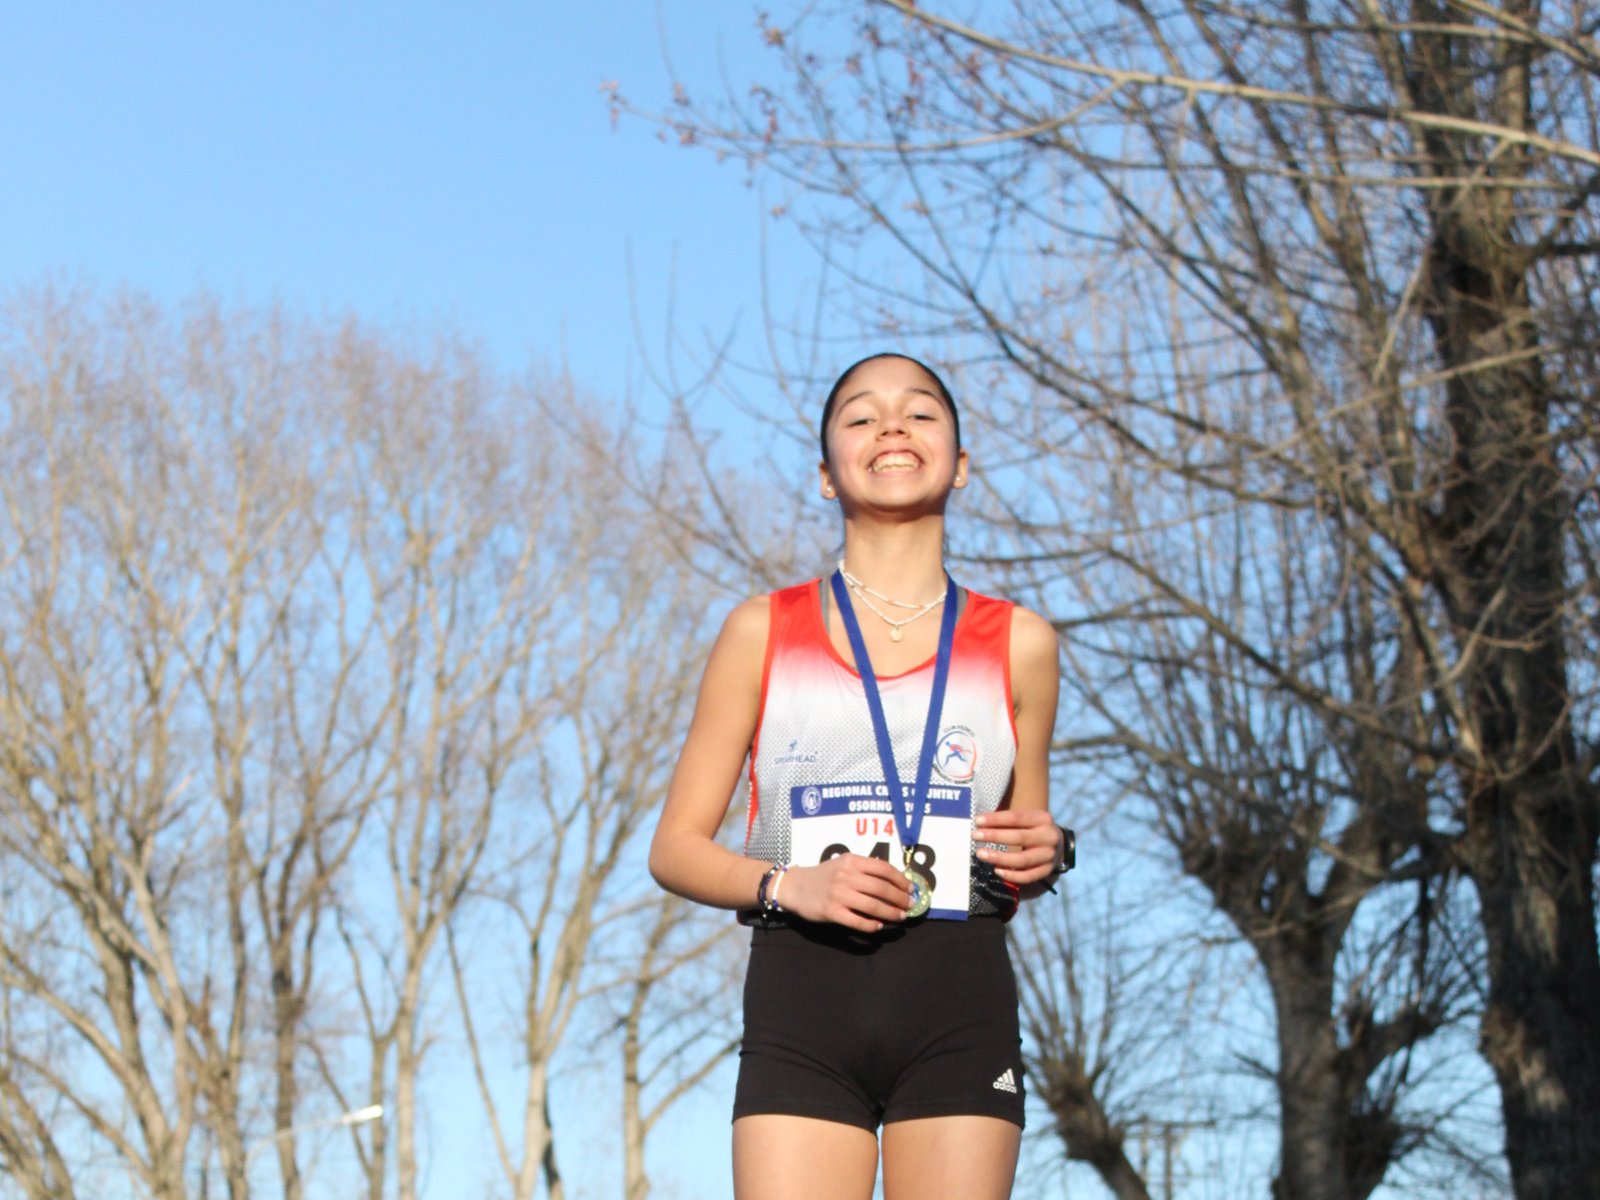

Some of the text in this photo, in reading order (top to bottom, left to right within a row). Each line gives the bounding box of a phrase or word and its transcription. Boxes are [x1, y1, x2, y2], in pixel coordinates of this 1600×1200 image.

[822, 785, 872, 798] REGIONAL
[875, 785, 908, 797] CRS
[848, 801, 892, 812] OSORNO
[856, 818, 893, 836] U14
[992, 1081, 1017, 1094] adidas
